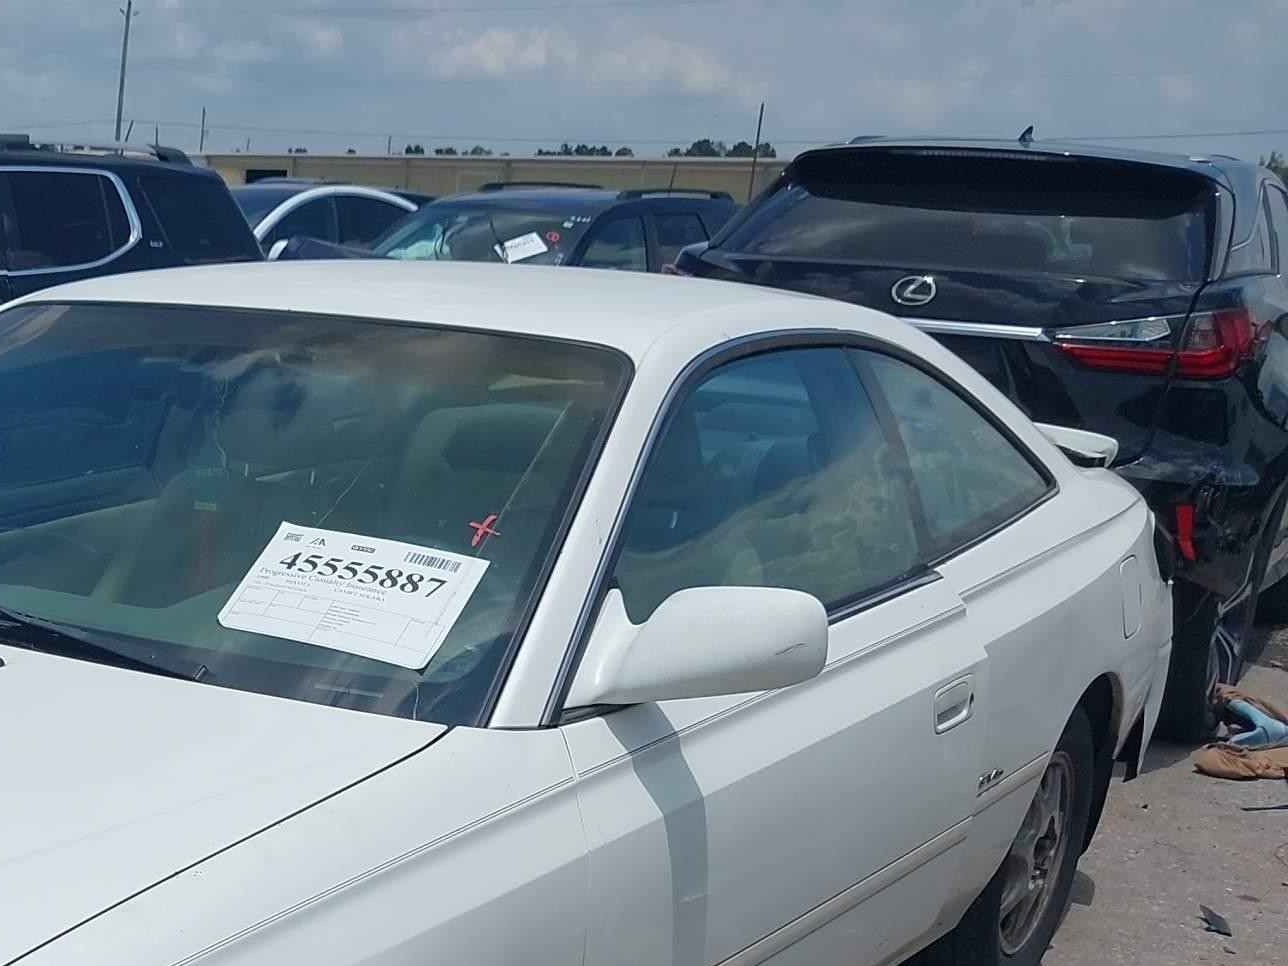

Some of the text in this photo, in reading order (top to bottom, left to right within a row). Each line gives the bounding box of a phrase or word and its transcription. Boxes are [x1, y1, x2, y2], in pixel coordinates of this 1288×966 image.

[259, 566, 307, 580] Progressive
[308, 574, 345, 588] Casualty
[346, 581, 388, 596] Insurance
[279, 551, 448, 598] 45555887
